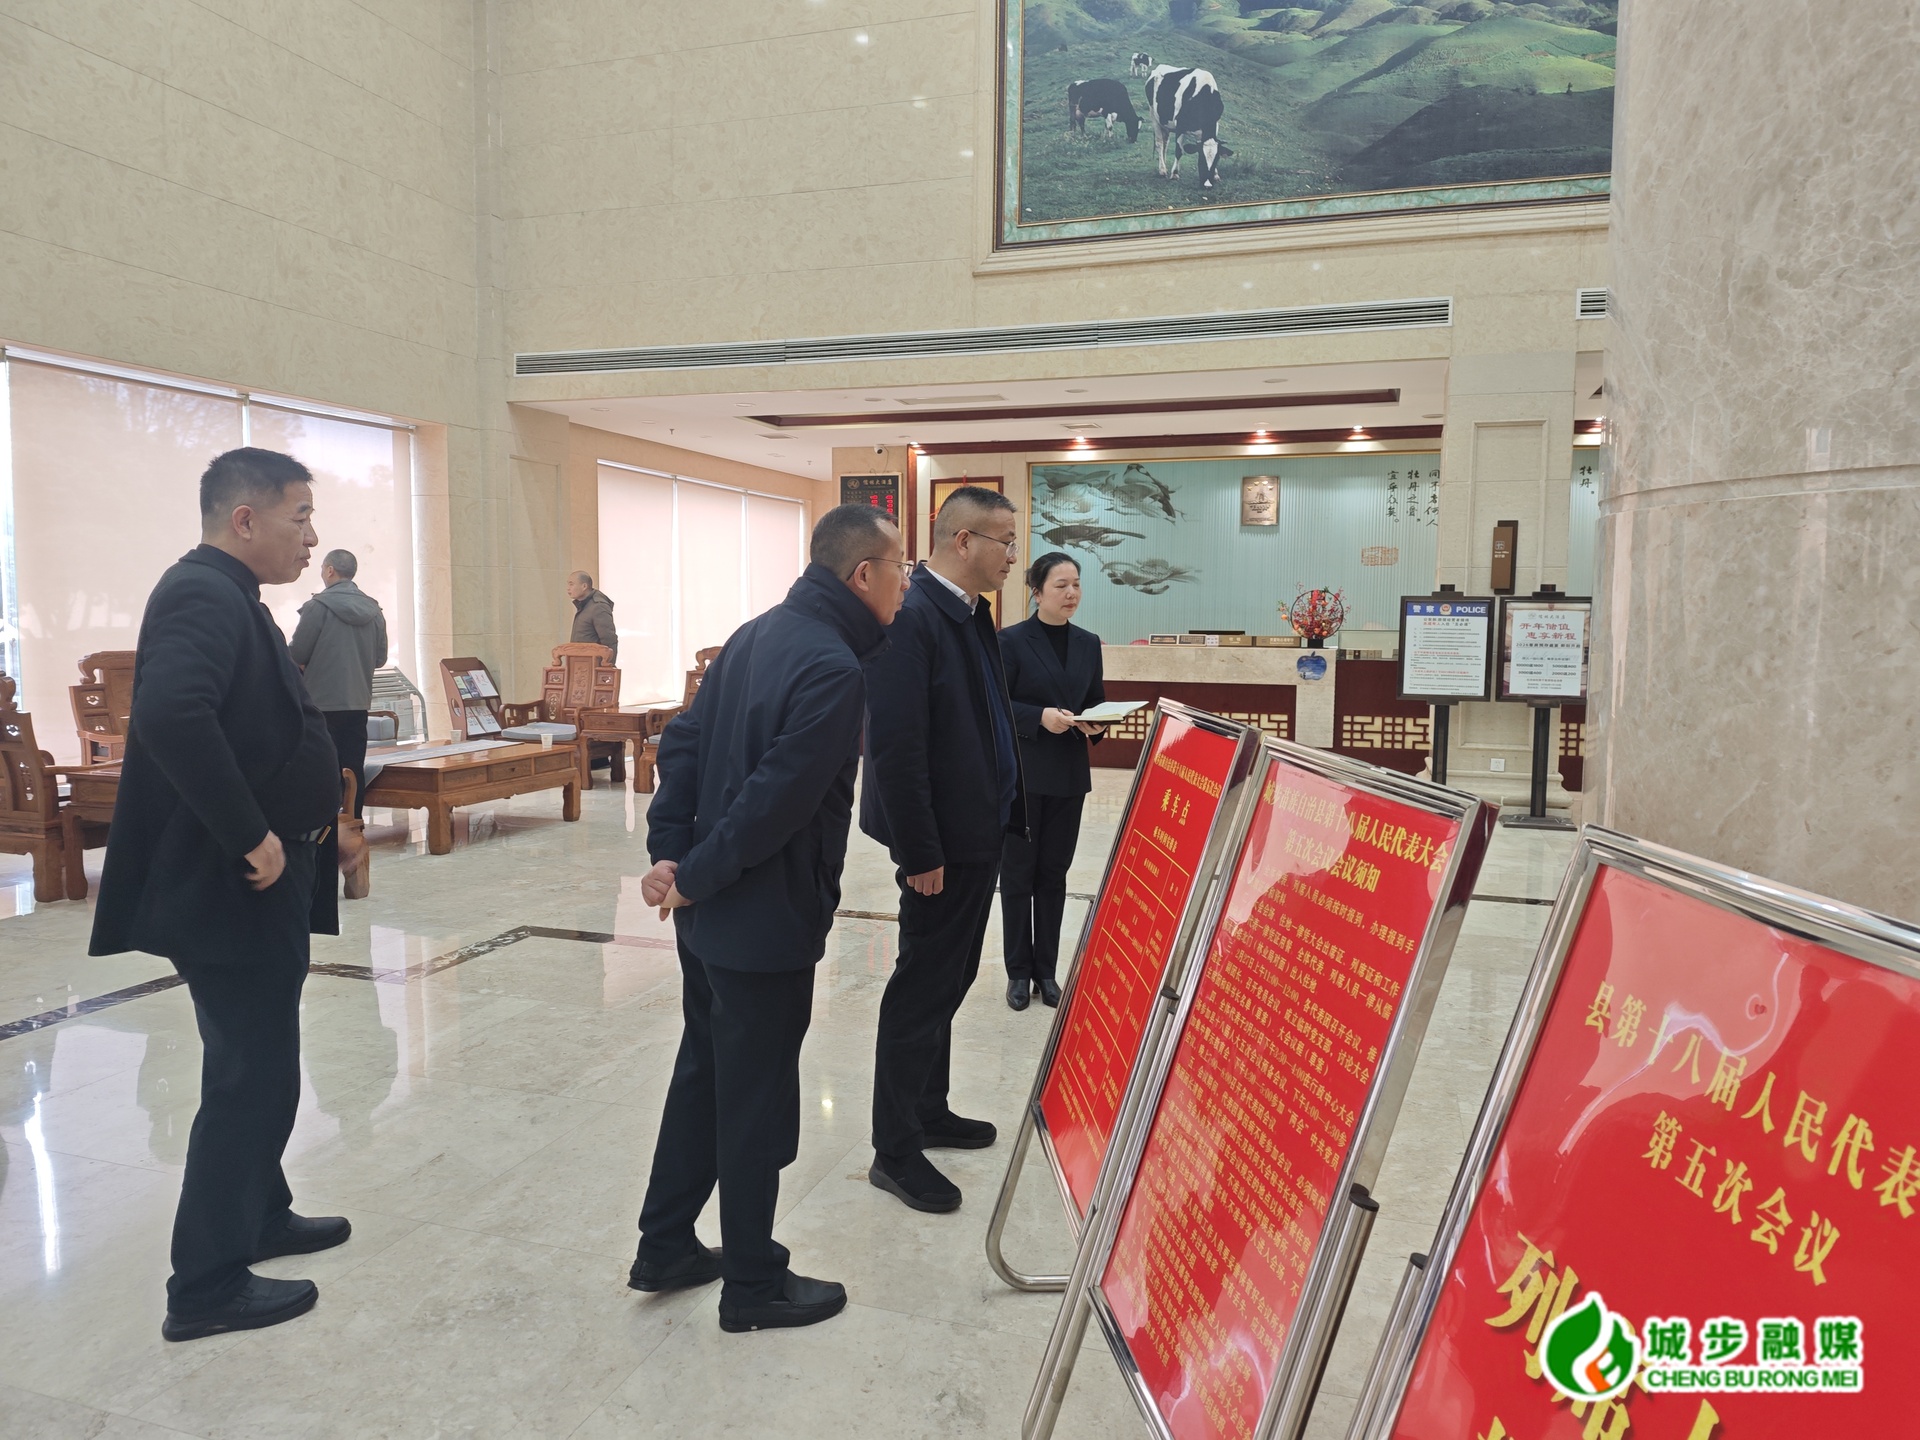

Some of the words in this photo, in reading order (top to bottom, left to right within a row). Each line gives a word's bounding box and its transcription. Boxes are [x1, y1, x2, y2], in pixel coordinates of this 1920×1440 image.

[1456, 606, 1486, 614] POLICE
[1519, 622, 1571, 631] 开年储值
[1525, 631, 1577, 641] 惠享新程
[1161, 788, 1190, 826] 乘车点
[1261, 778, 1452, 875] 城步苗族自治县第十八届人民代表大会
[1281, 826, 1383, 894] 第五次会议会议须知
[1585, 981, 1920, 1218] 县第十八届人民代表
[1641, 1110, 1840, 1286] 第五次会议
